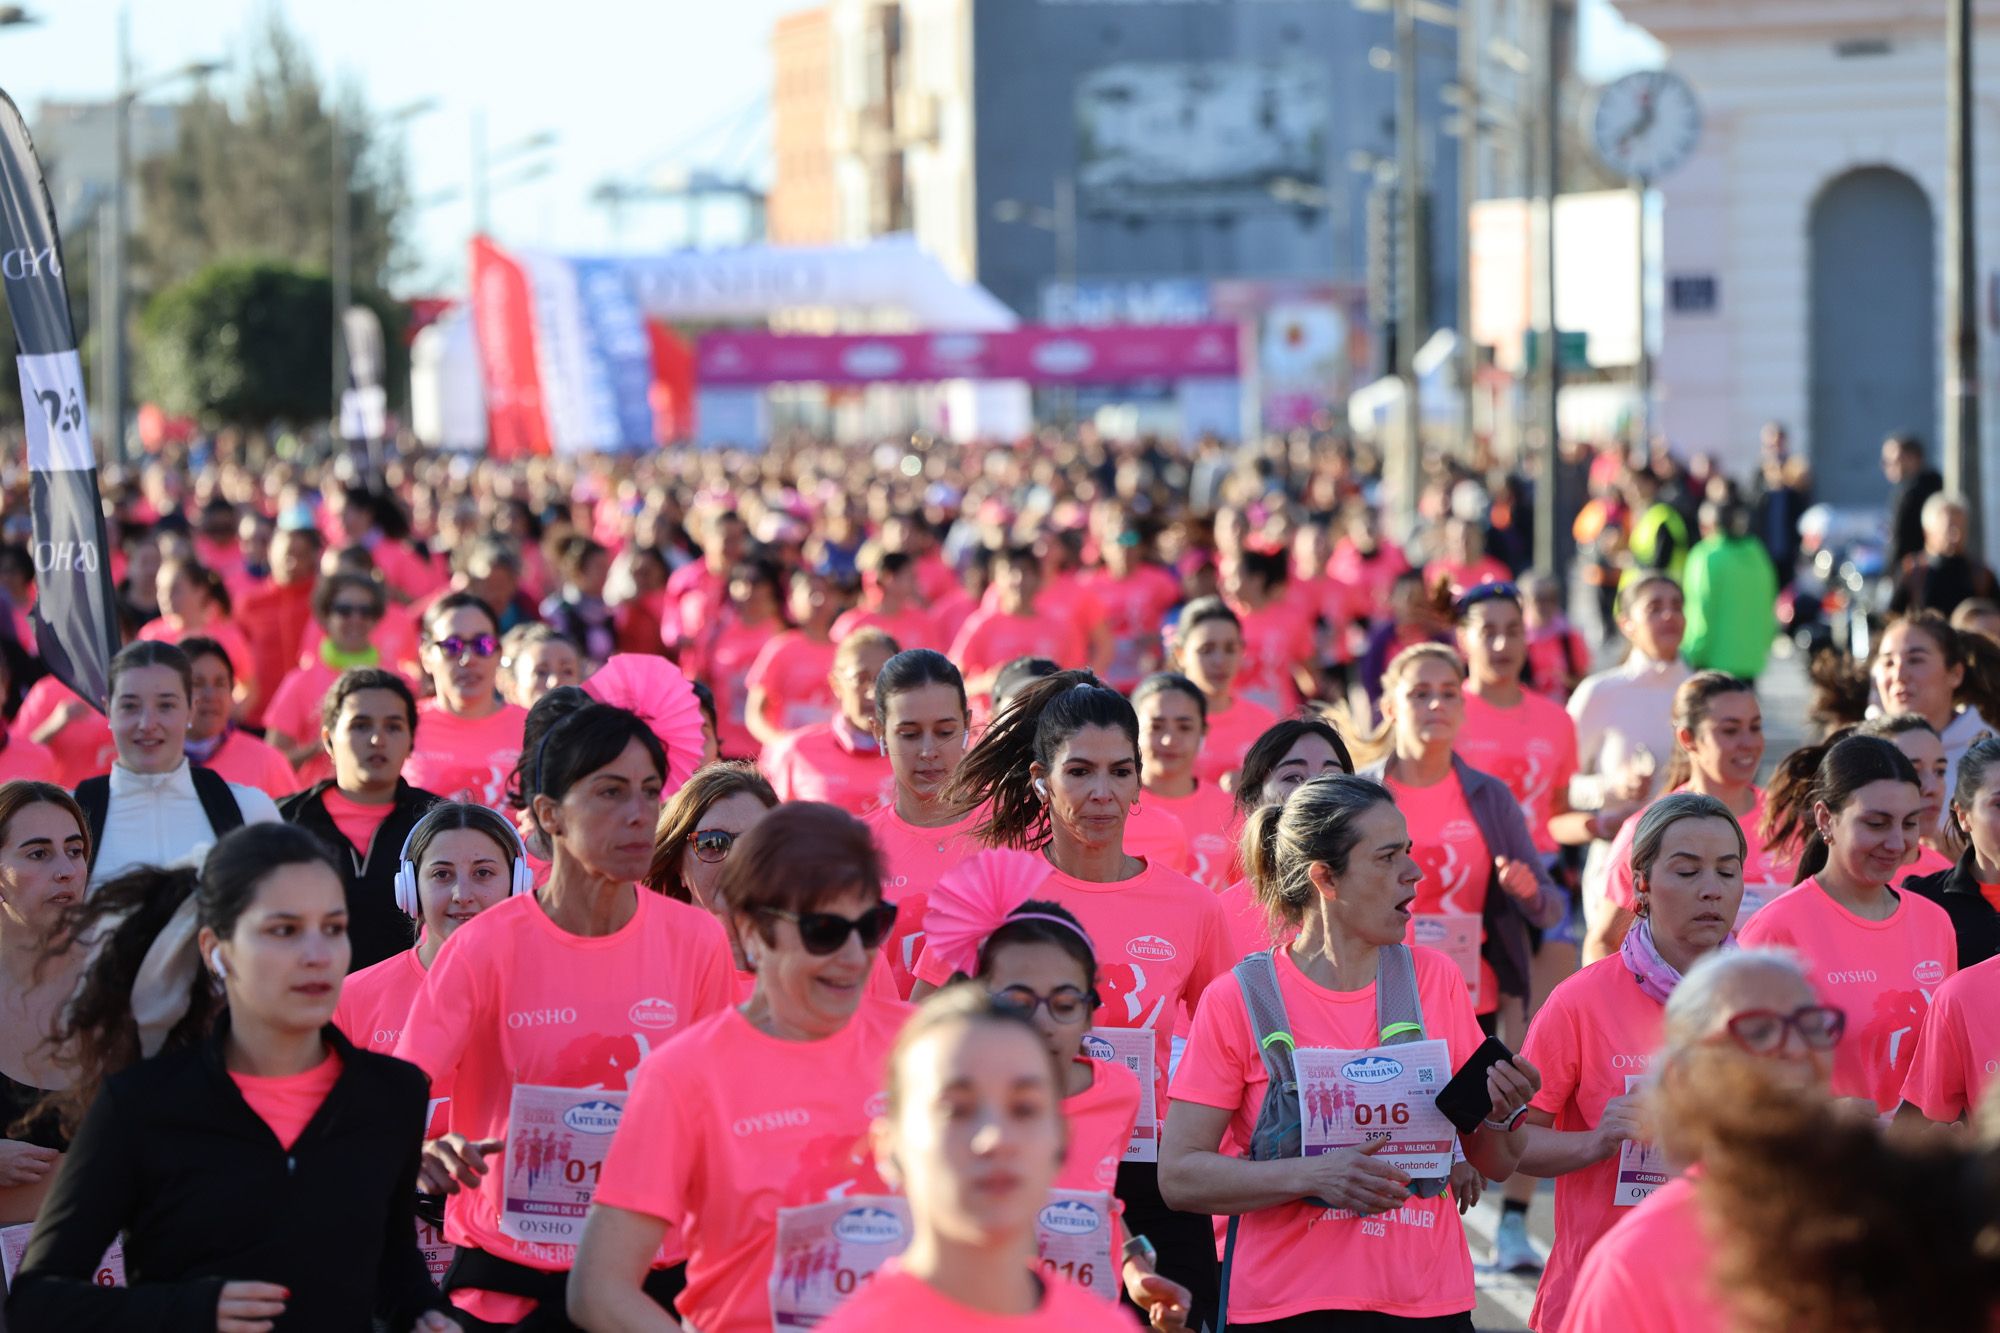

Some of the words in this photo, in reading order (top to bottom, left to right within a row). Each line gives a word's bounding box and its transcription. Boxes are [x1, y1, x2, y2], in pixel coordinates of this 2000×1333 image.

[1131, 943, 1173, 957] ASTURIANA
[1828, 969, 1877, 985] OYSHO
[508, 1007, 576, 1029] OYSHO
[374, 1030, 400, 1043] OY
[1346, 1066, 1399, 1078] ASTURIANA
[568, 1111, 617, 1126] ASTURIAN
[1354, 1102, 1410, 1126] 016
[733, 1107, 810, 1137] OYSHO
[1404, 1143, 1436, 1153] VALENCIA
[1394, 1160, 1439, 1171] Santander
[1635, 1173, 1666, 1183] CARRERA
[523, 1202, 559, 1213] CARRERA
[560, 1206, 571, 1215] DE
[573, 1206, 583, 1216] LA
[1400, 1206, 1435, 1229] MUJER
[519, 1219, 573, 1236] OYSHO
[1361, 1220, 1386, 1238] 2025
